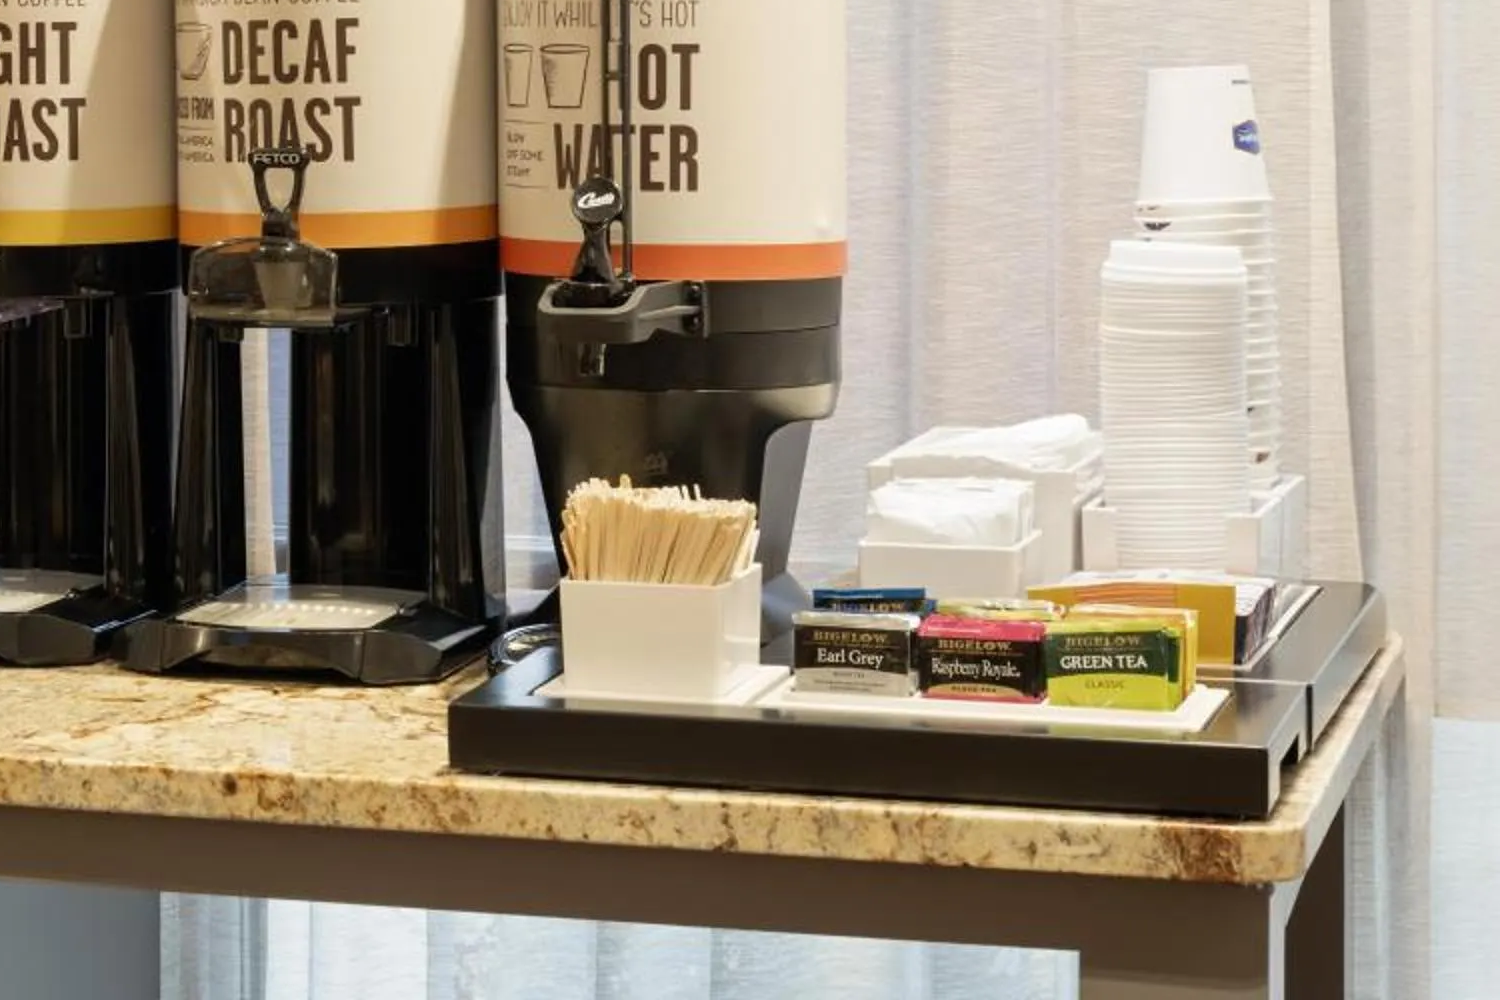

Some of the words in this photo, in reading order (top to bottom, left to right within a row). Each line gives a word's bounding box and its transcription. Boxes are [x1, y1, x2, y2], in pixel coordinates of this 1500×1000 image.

[553, 1, 599, 28] WHIL
[661, 0, 699, 28] HOT
[222, 18, 360, 85] DECAF
[223, 97, 361, 163] ROAST
[813, 630, 888, 644] BIGELOW
[817, 647, 846, 664] Earl
[848, 648, 884, 670] Grey
[1059, 654, 1115, 670] GREEN
[1117, 654, 1148, 669] TEA
